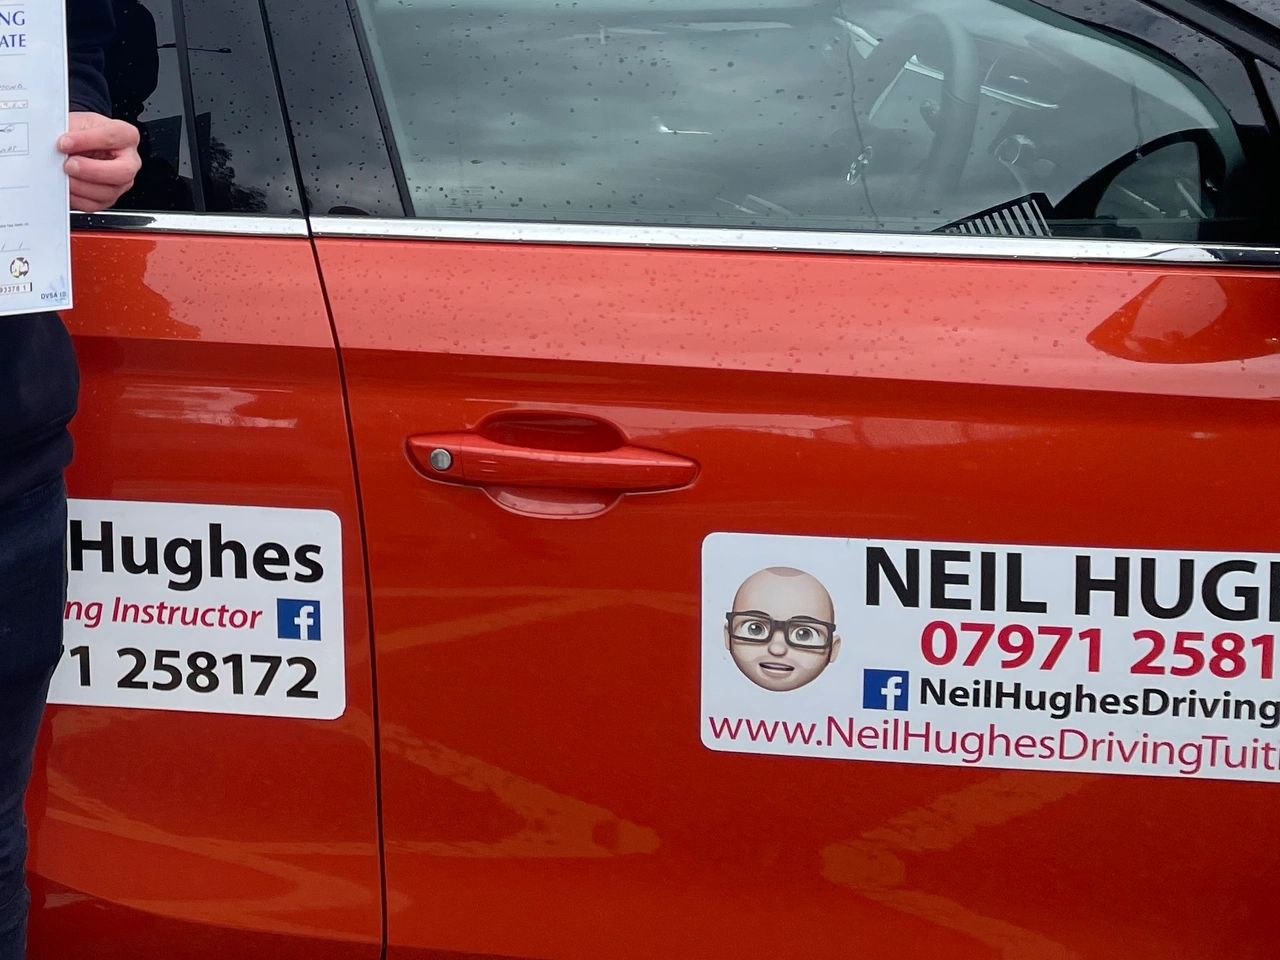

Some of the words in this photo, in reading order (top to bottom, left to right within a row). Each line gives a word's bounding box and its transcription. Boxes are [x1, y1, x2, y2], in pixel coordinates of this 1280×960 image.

[40, 292, 58, 300] DVSA
[70, 519, 324, 591] Hughes
[865, 546, 1048, 615] NEIL
[1074, 554, 1280, 623] HUG
[111, 597, 264, 630] Instructor
[116, 646, 320, 700] 258172
[919, 620, 1103, 674] 07971
[919, 676, 1280, 730] NeilHughesDriving
[708, 714, 1280, 776] www.NeilHughesDrivingTuit
